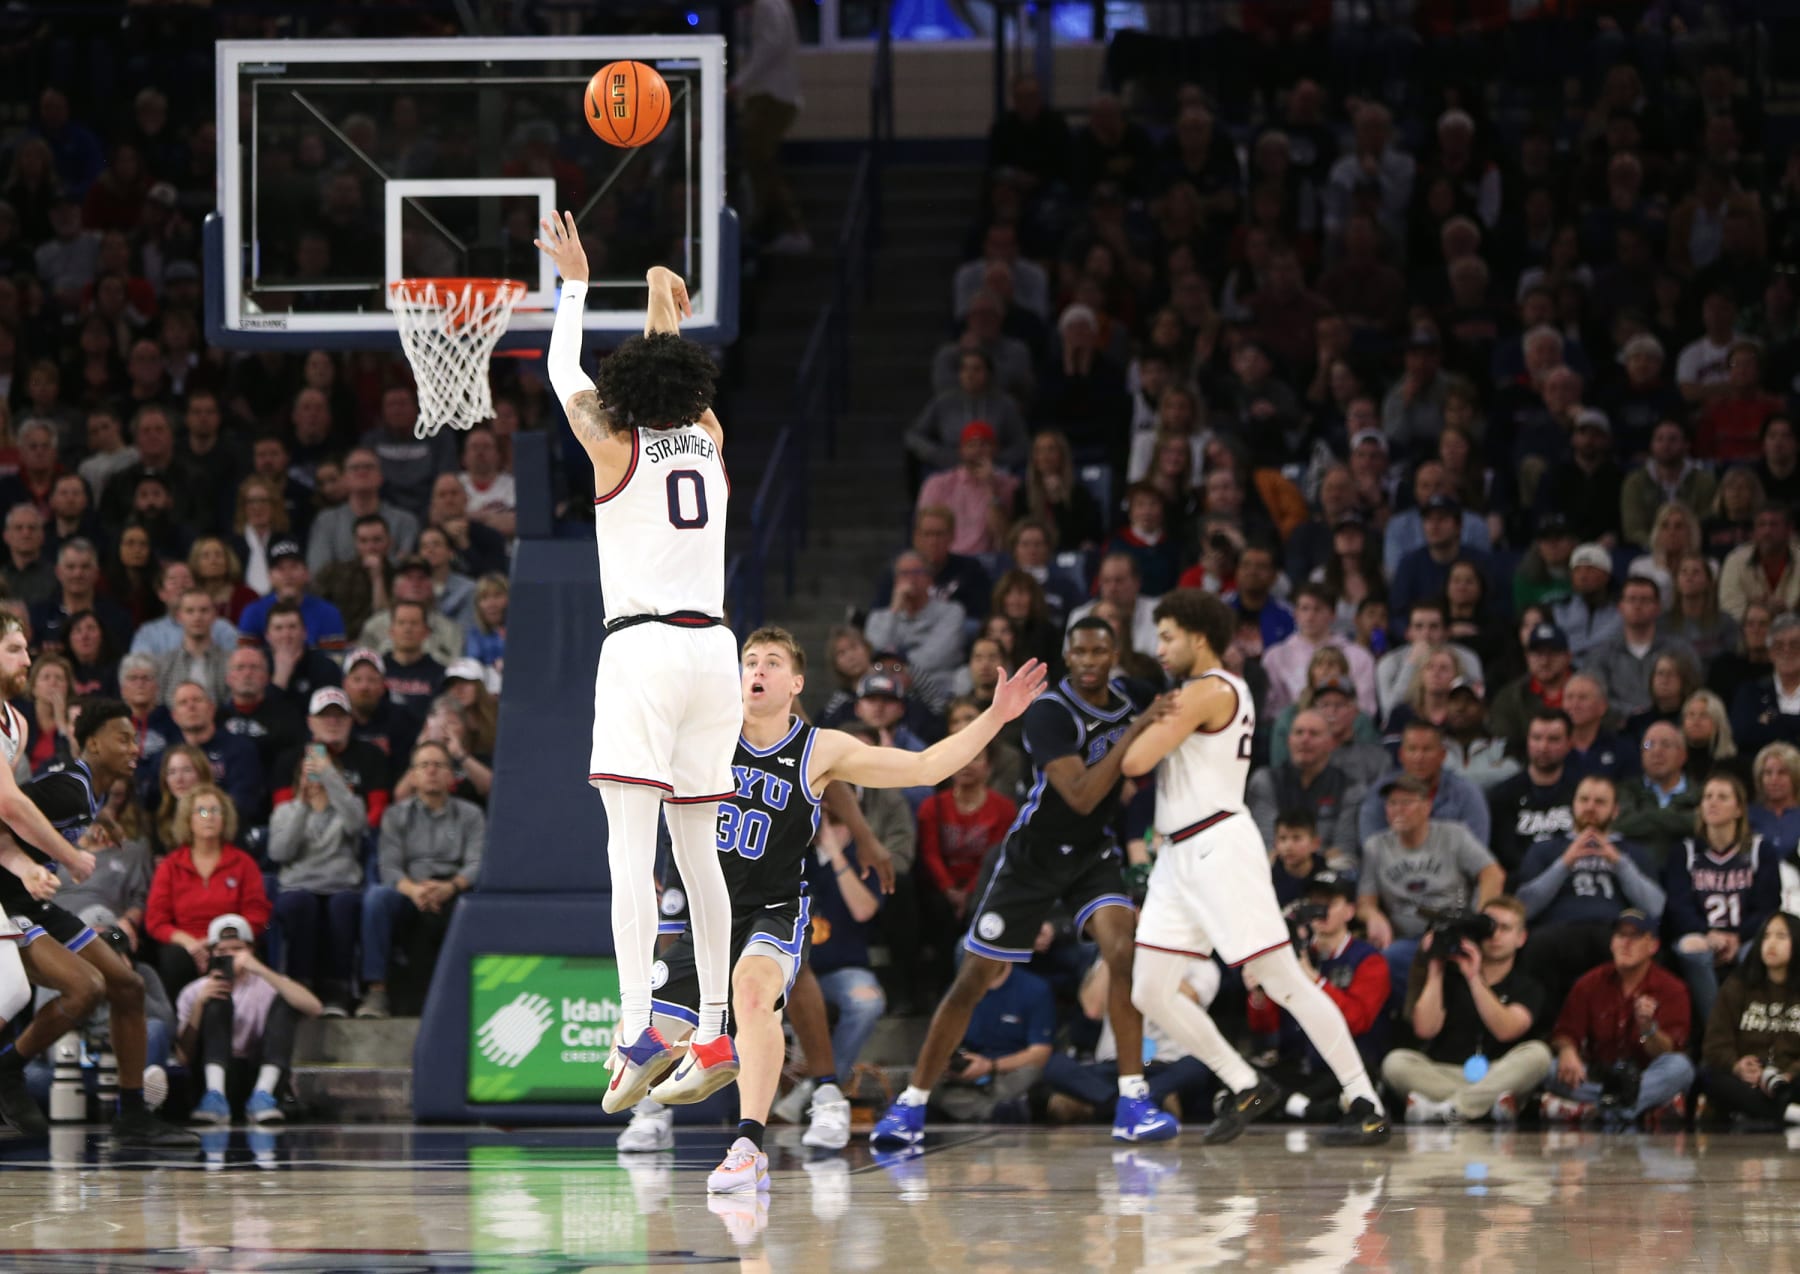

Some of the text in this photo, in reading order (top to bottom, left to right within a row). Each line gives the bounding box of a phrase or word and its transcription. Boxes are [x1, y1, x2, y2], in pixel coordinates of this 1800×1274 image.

[613, 74, 626, 118] ELITE
[239, 319, 287, 330] SPALDING
[645, 434, 714, 464] STRAWTHER
[666, 469, 709, 530] 0
[730, 764, 793, 811] YU
[716, 801, 772, 860] 30
[1704, 892, 1741, 928] 21
[561, 997, 622, 1022] Idah
